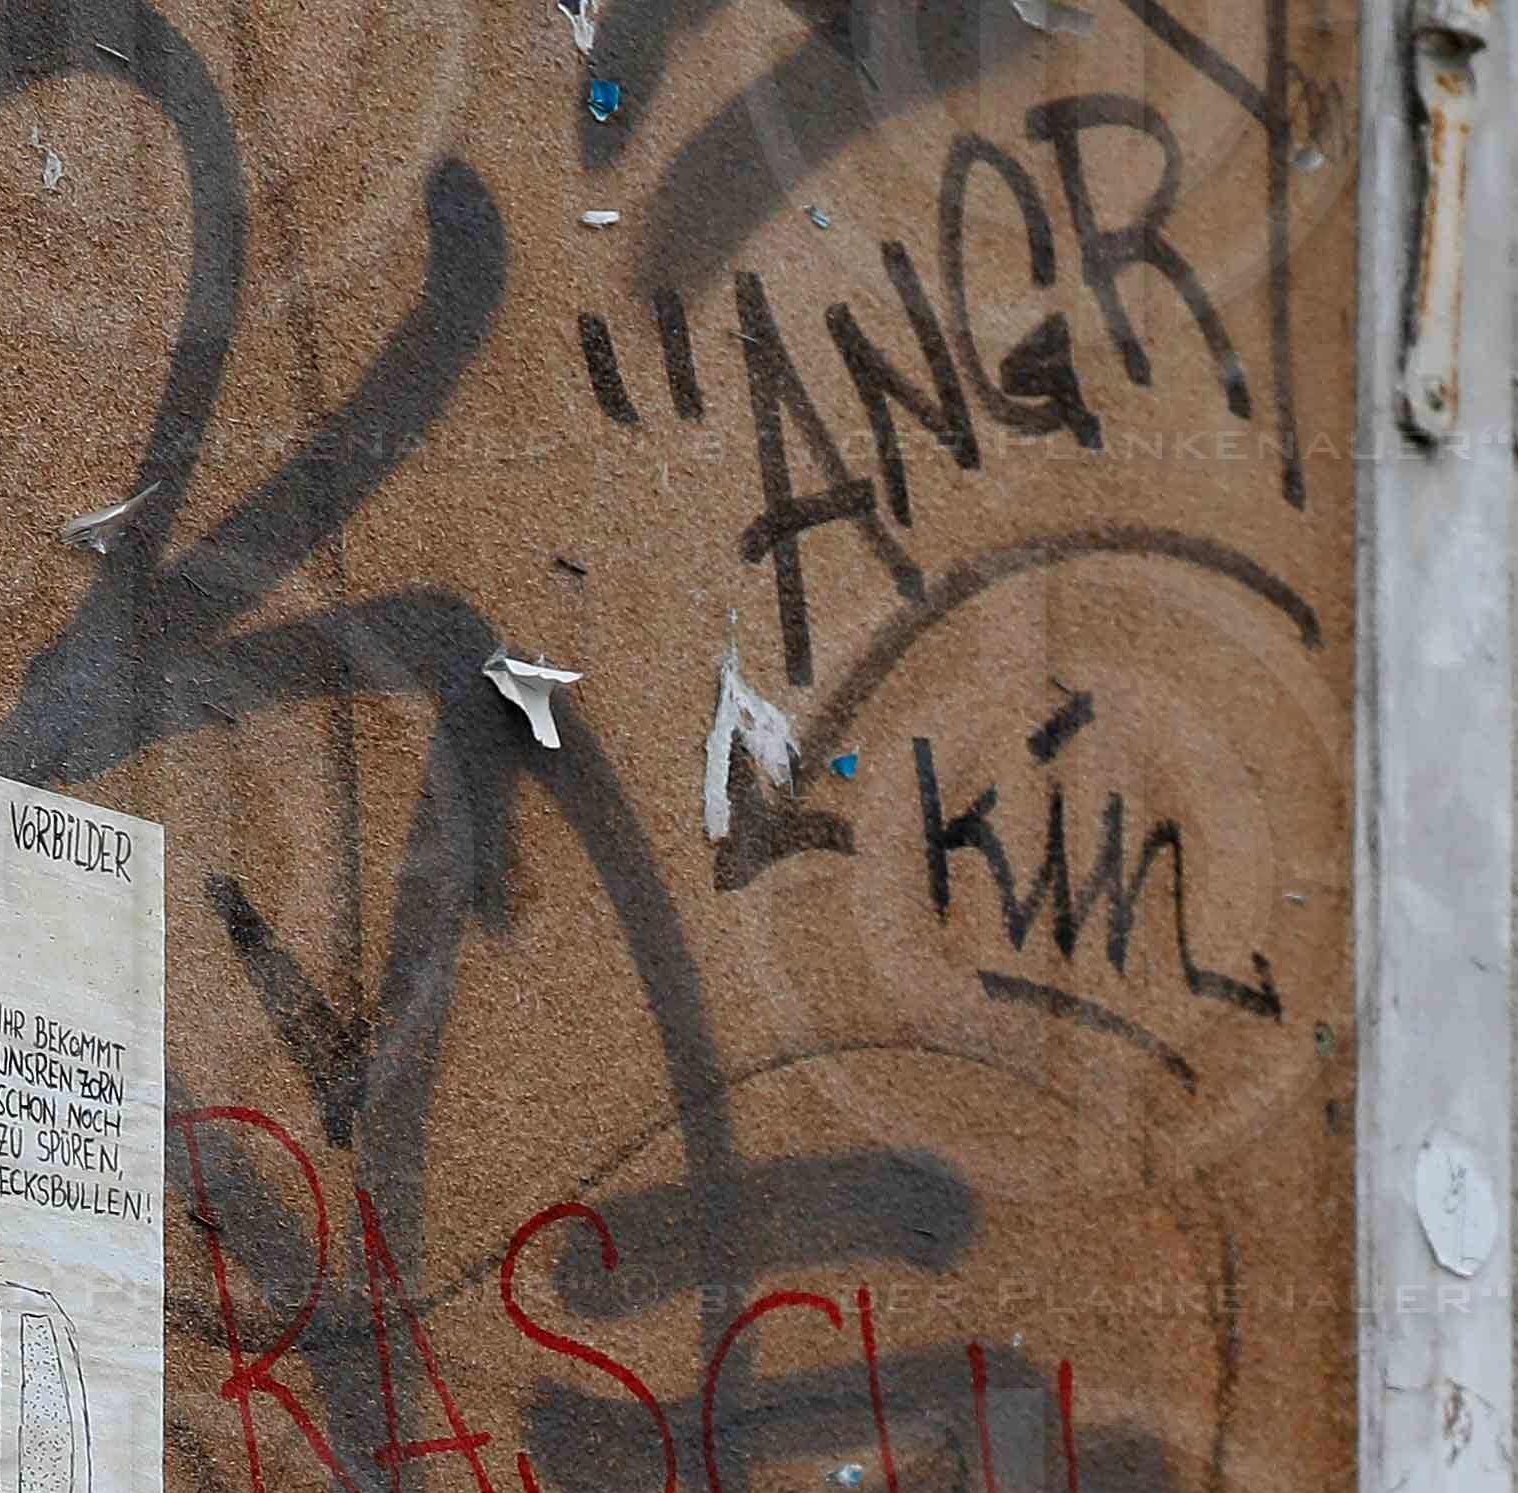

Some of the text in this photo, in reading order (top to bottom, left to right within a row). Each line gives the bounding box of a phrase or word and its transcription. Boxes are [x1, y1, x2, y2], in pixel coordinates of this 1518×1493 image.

[34, 1015, 126, 1071] BEKOMMT
[77, 1069, 124, 1106] ZORN
[67, 1103, 121, 1137] NOCH
[37, 1128, 123, 1181] SPÜREN,
